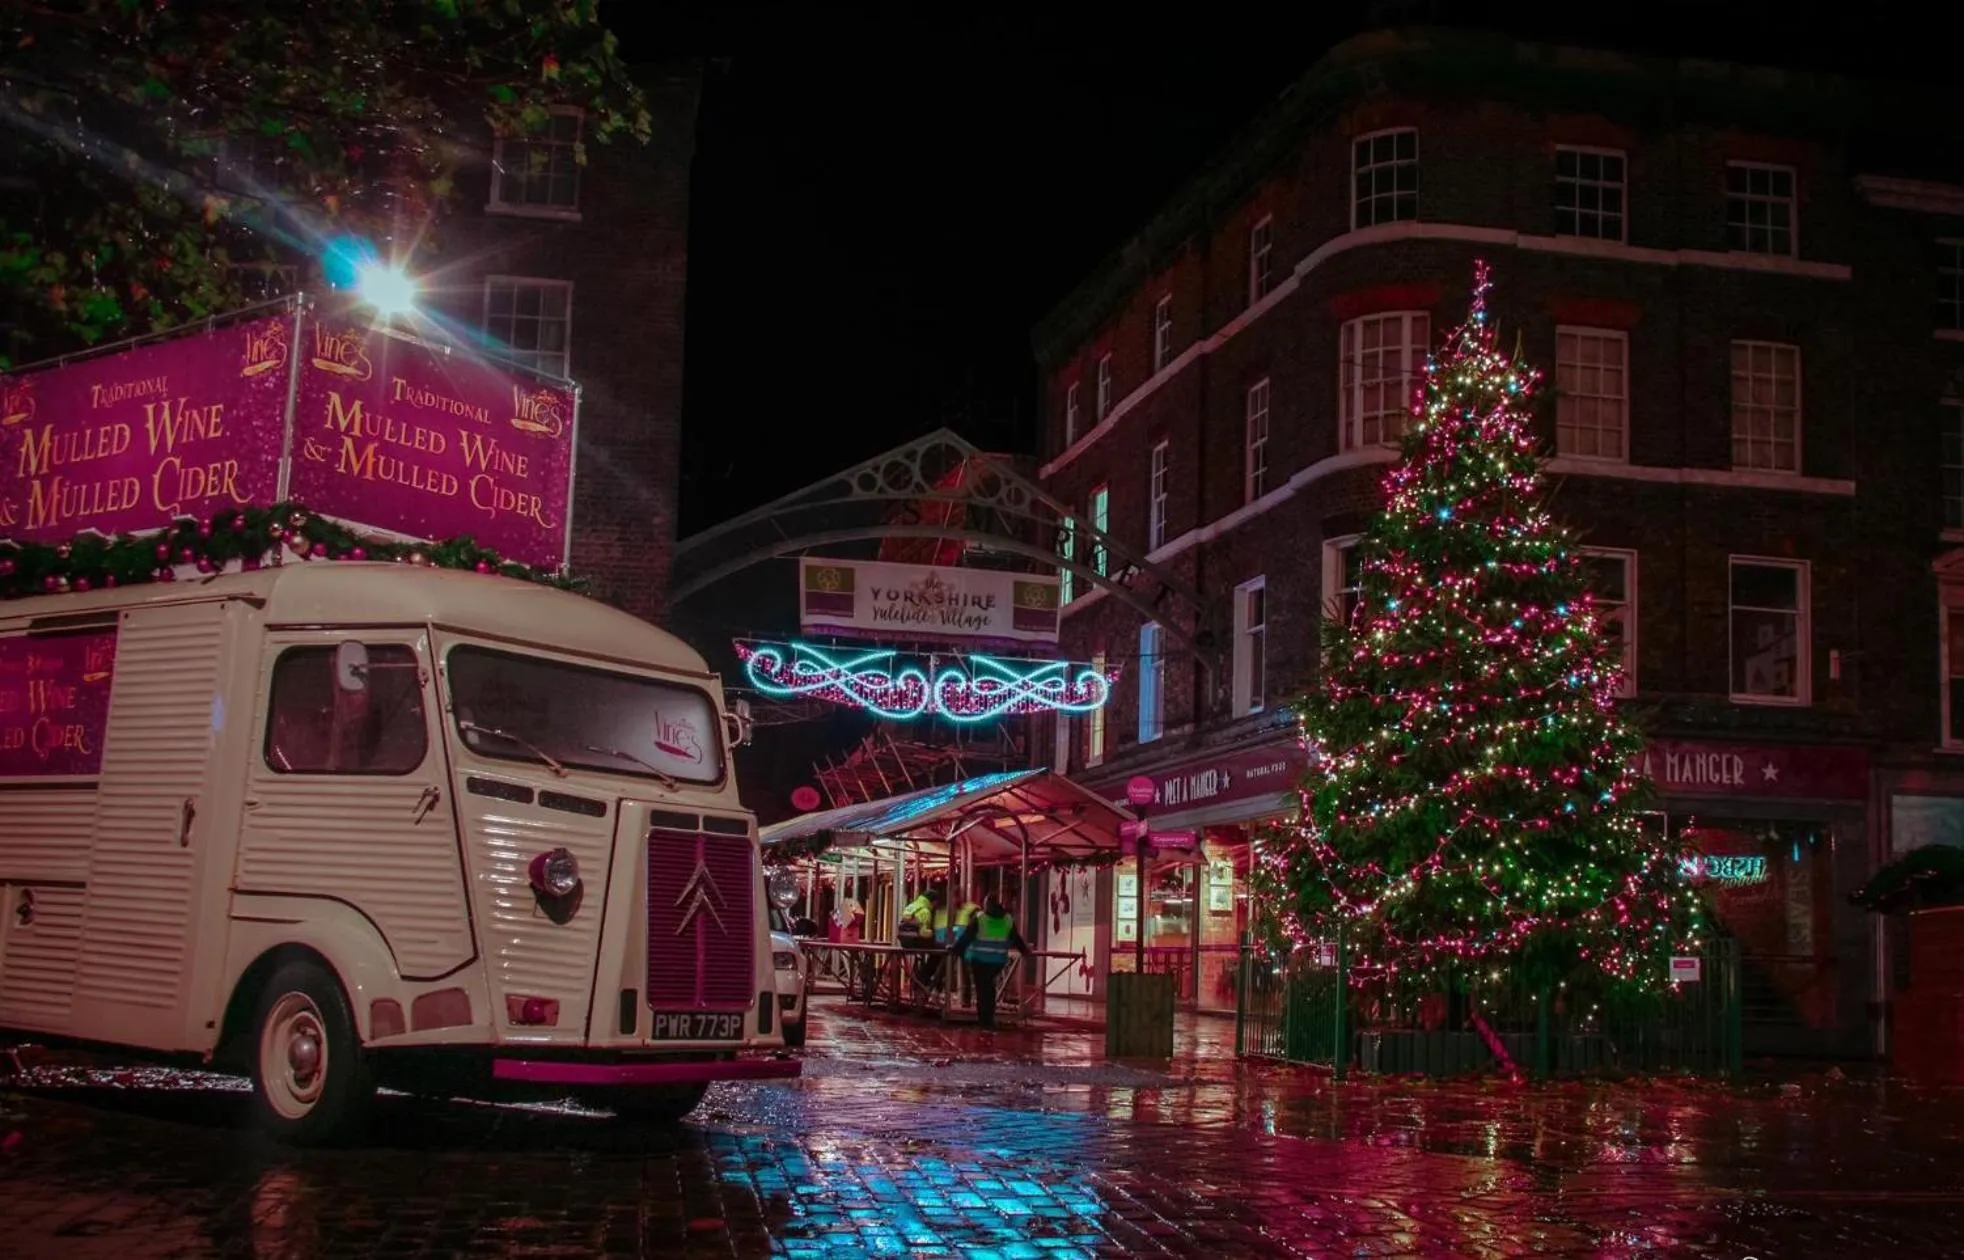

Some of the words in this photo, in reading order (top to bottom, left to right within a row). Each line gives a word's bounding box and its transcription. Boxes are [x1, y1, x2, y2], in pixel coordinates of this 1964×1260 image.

[17, 424, 131, 478] MULLED
[143, 396, 224, 456] WINE
[324, 391, 446, 454] MULLED
[457, 428, 529, 479] WINE
[24, 476, 141, 530] MULLED
[152, 456, 255, 516] CIDER
[303, 437, 332, 462] &
[336, 435, 459, 496] MULLED
[469, 474, 557, 528] CIDER
[869, 586, 998, 612] YORKSHIRE
[872, 604, 928, 625] Yuletide
[938, 610, 993, 632] Village
[1666, 752, 1745, 785] MANGER
[1164, 776, 1181, 807] PRET
[1182, 776, 1189, 803] A
[1190, 769, 1218, 801] MANGER
[655, 1014, 690, 1038] PWR
[695, 1014, 741, 1038] 773P
